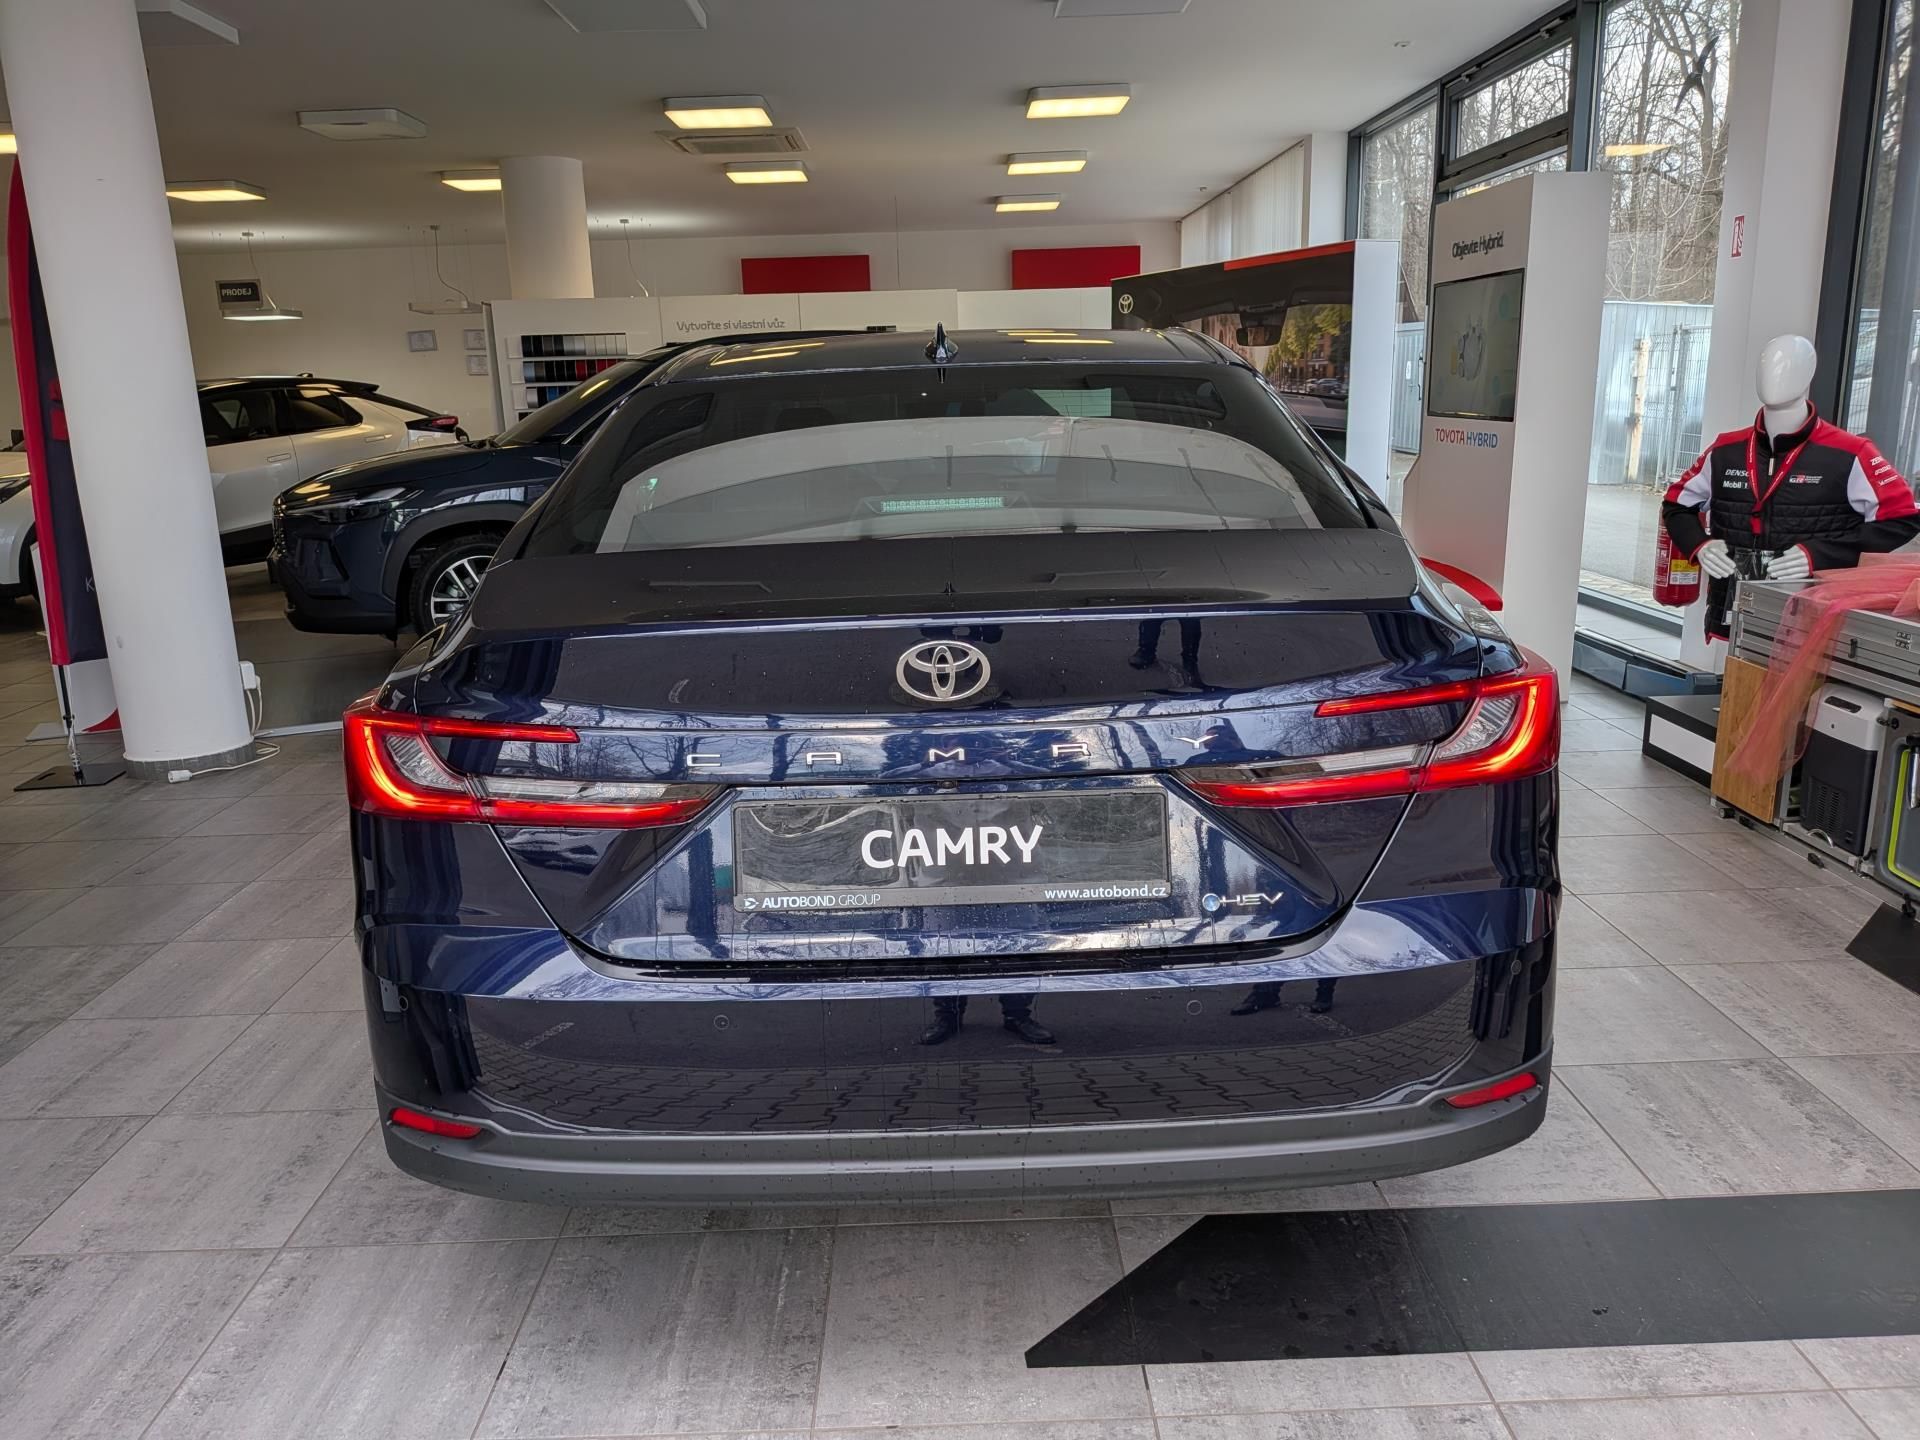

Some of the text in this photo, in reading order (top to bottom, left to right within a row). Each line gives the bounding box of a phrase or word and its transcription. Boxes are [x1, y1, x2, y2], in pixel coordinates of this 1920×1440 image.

[1479, 231, 1504, 255] Hybrid
[221, 287, 252, 297] PRODEJ
[676, 317, 785, 333] Vytvořte si vlastní vůz
[1435, 428, 1498, 448] TOYOTA HYBRID
[1722, 480, 1742, 489] Mobil
[686, 734, 1217, 768] CAMRY
[861, 824, 1043, 869] CAMRY
[762, 893, 881, 907] AUTOBOND GROUP
[1045, 884, 1167, 900] www.autobond.cz
[1221, 892, 1284, 906] HEV
